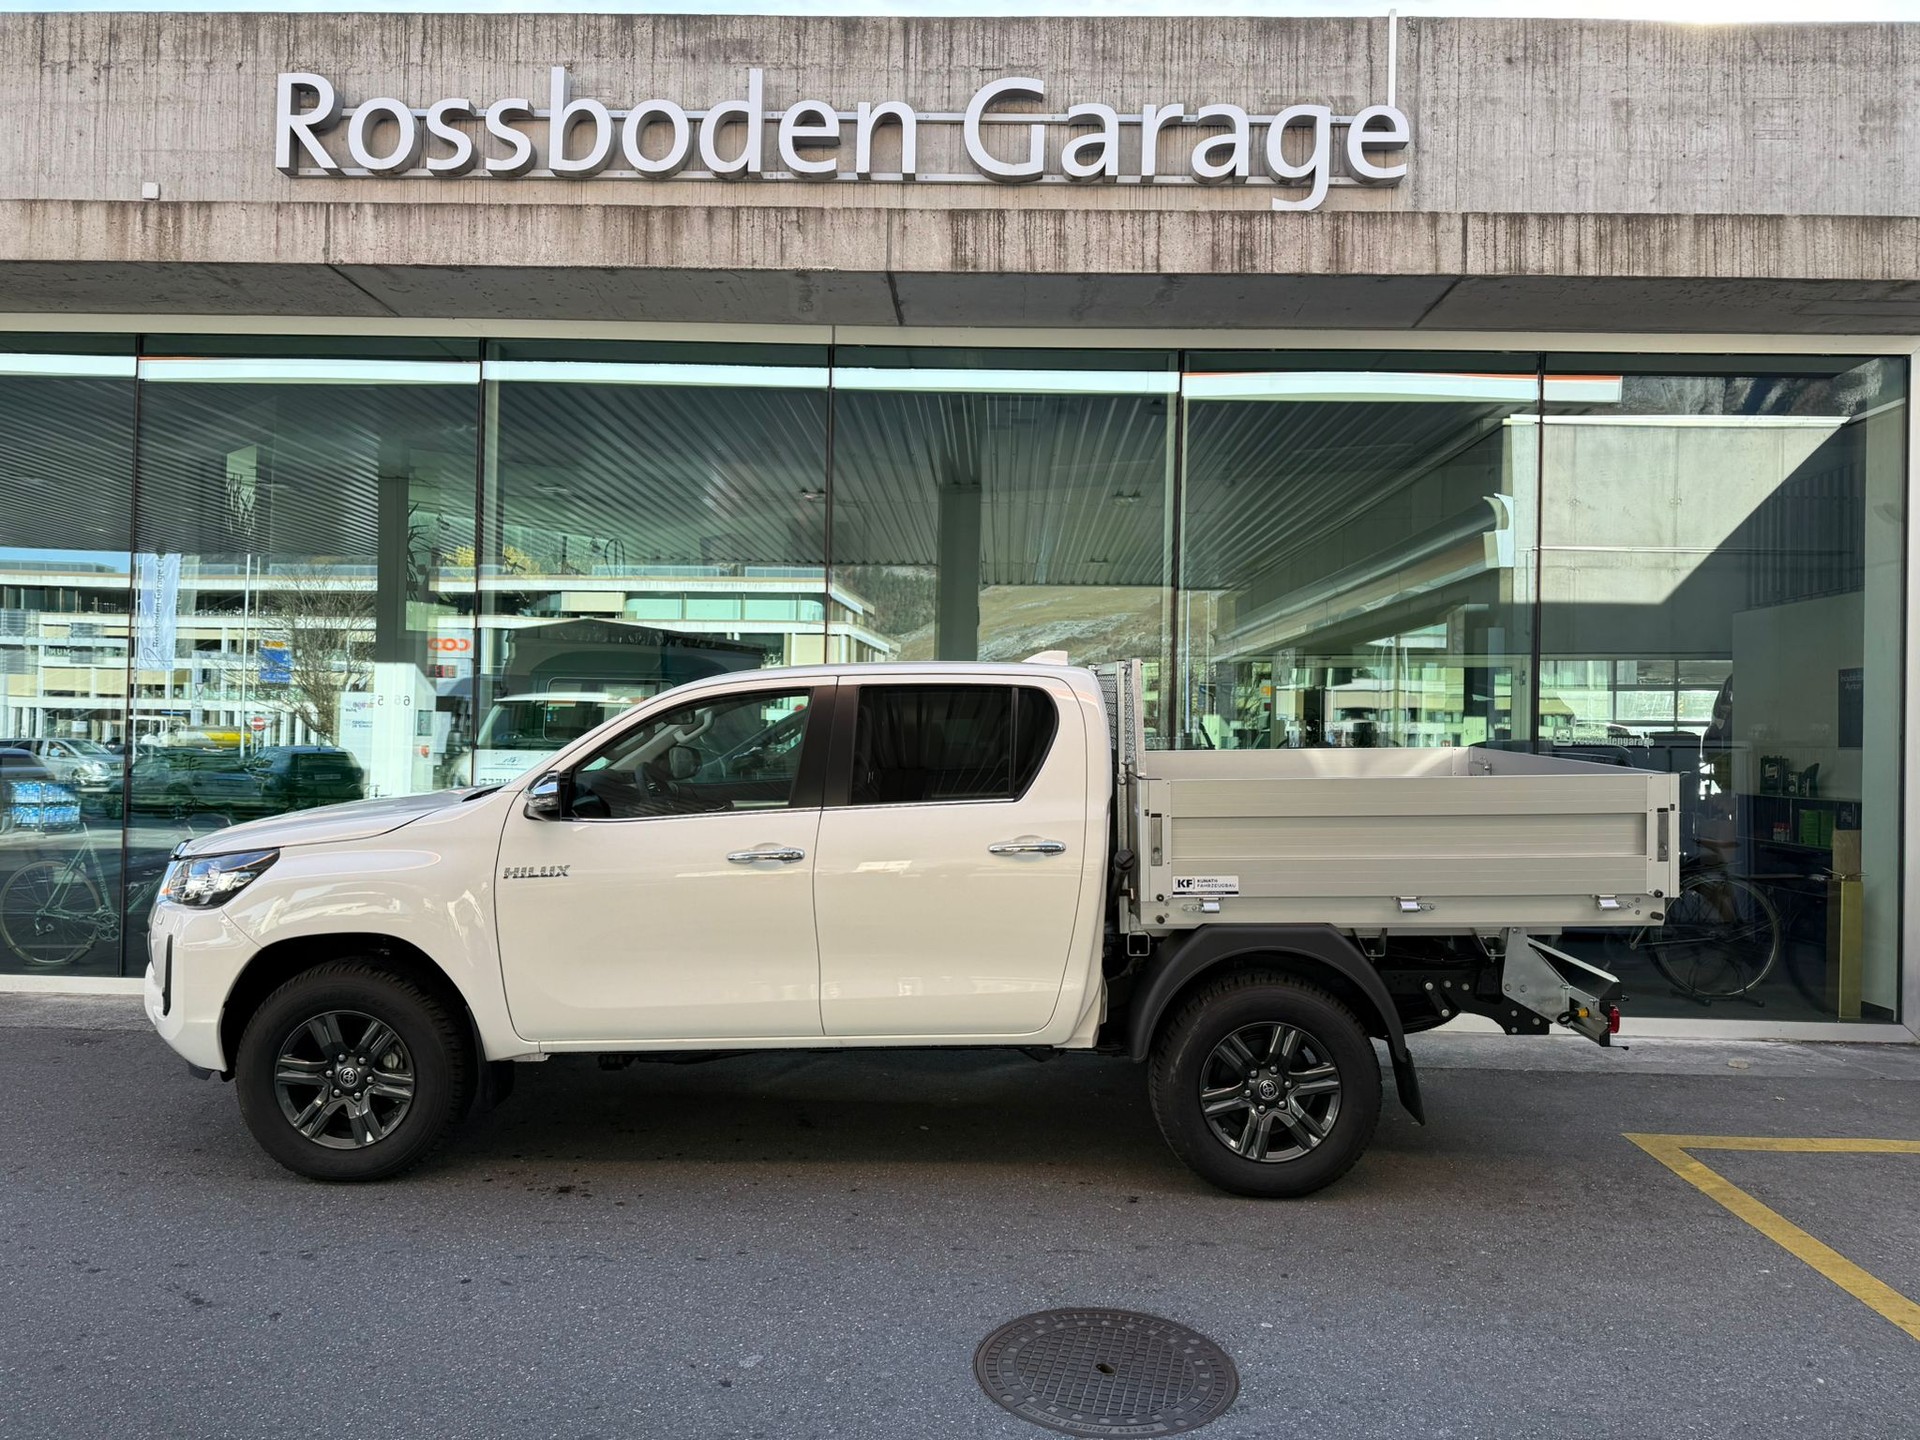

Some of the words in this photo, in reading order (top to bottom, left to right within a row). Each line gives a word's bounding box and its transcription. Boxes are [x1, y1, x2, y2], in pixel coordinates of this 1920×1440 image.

[275, 66, 919, 180] Rossboden
[963, 76, 1411, 212] Garage
[503, 865, 571, 879] HILUX
